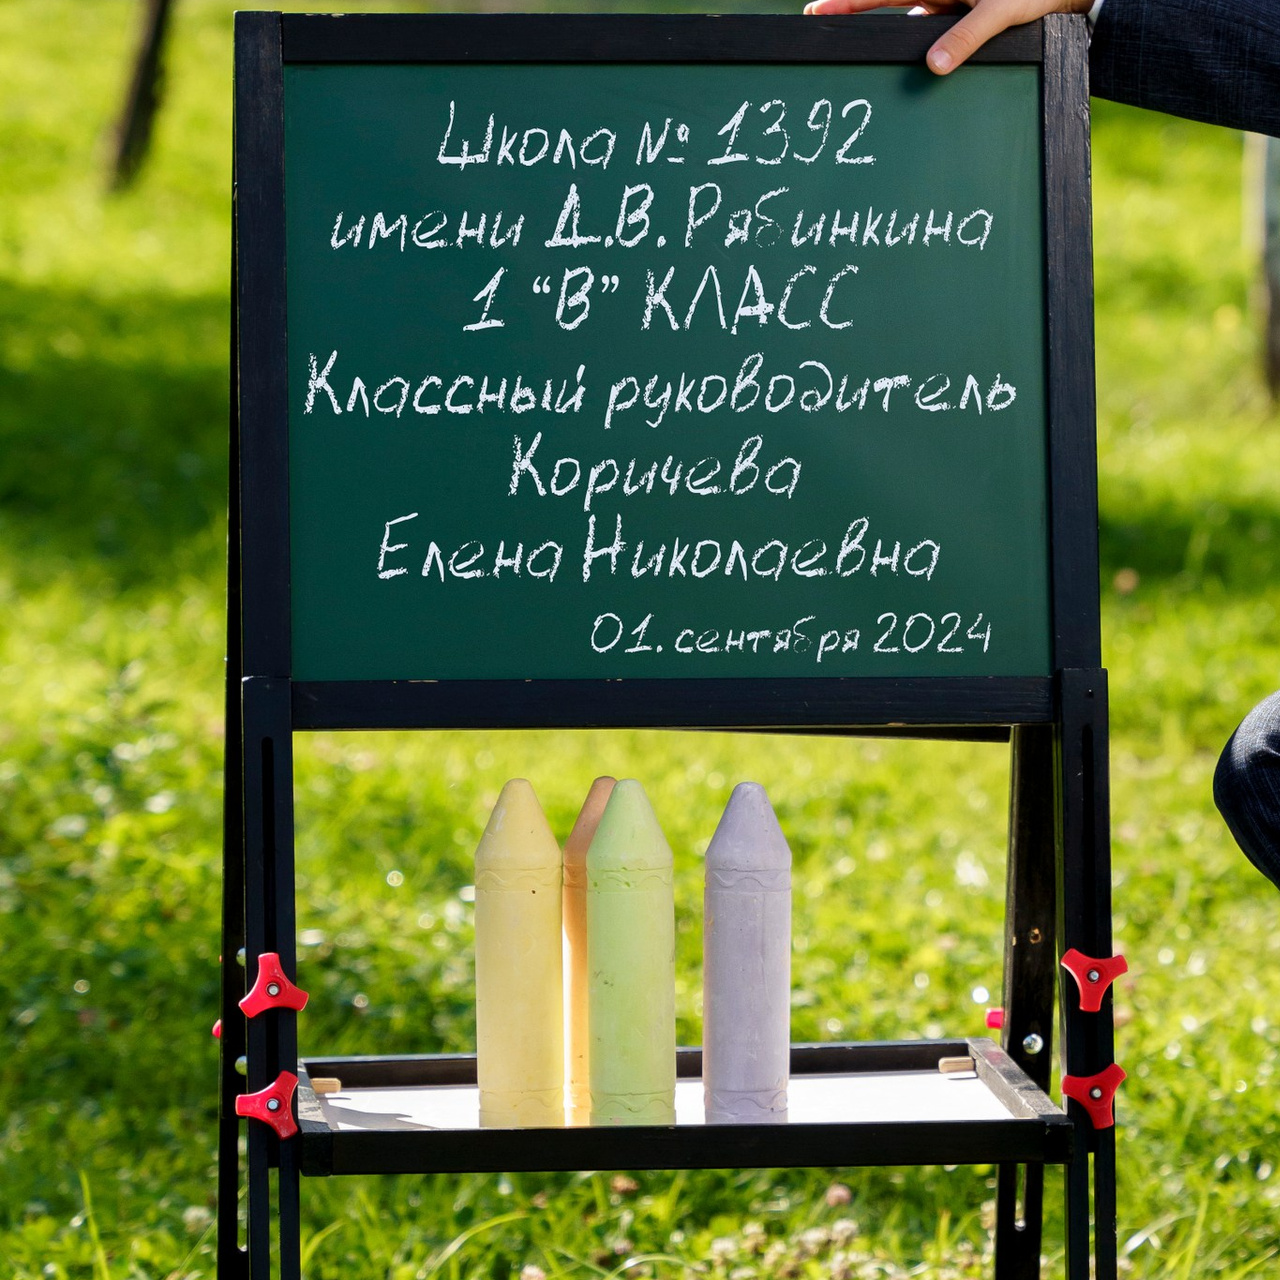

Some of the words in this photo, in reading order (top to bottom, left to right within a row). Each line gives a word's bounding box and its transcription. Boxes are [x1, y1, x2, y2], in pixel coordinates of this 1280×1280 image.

[437, 101, 616, 170] Школа
[636, 118, 689, 165] №
[707, 99, 876, 165] 1392
[331, 211, 524, 251] имени
[545, 183, 666, 248] Д.В.
[685, 183, 993, 250] Рябинкина
[463, 267, 508, 331] 1
[641, 264, 859, 335] КЛАСС
[304, 350, 586, 418] Классный
[605, 352, 1016, 429] руководитель
[508, 432, 801, 511] Коричева
[377, 513, 563, 582] Елена
[583, 508, 940, 582] Николаевна
[675, 623, 860, 662] сентября
[874, 613, 991, 653] 2024
